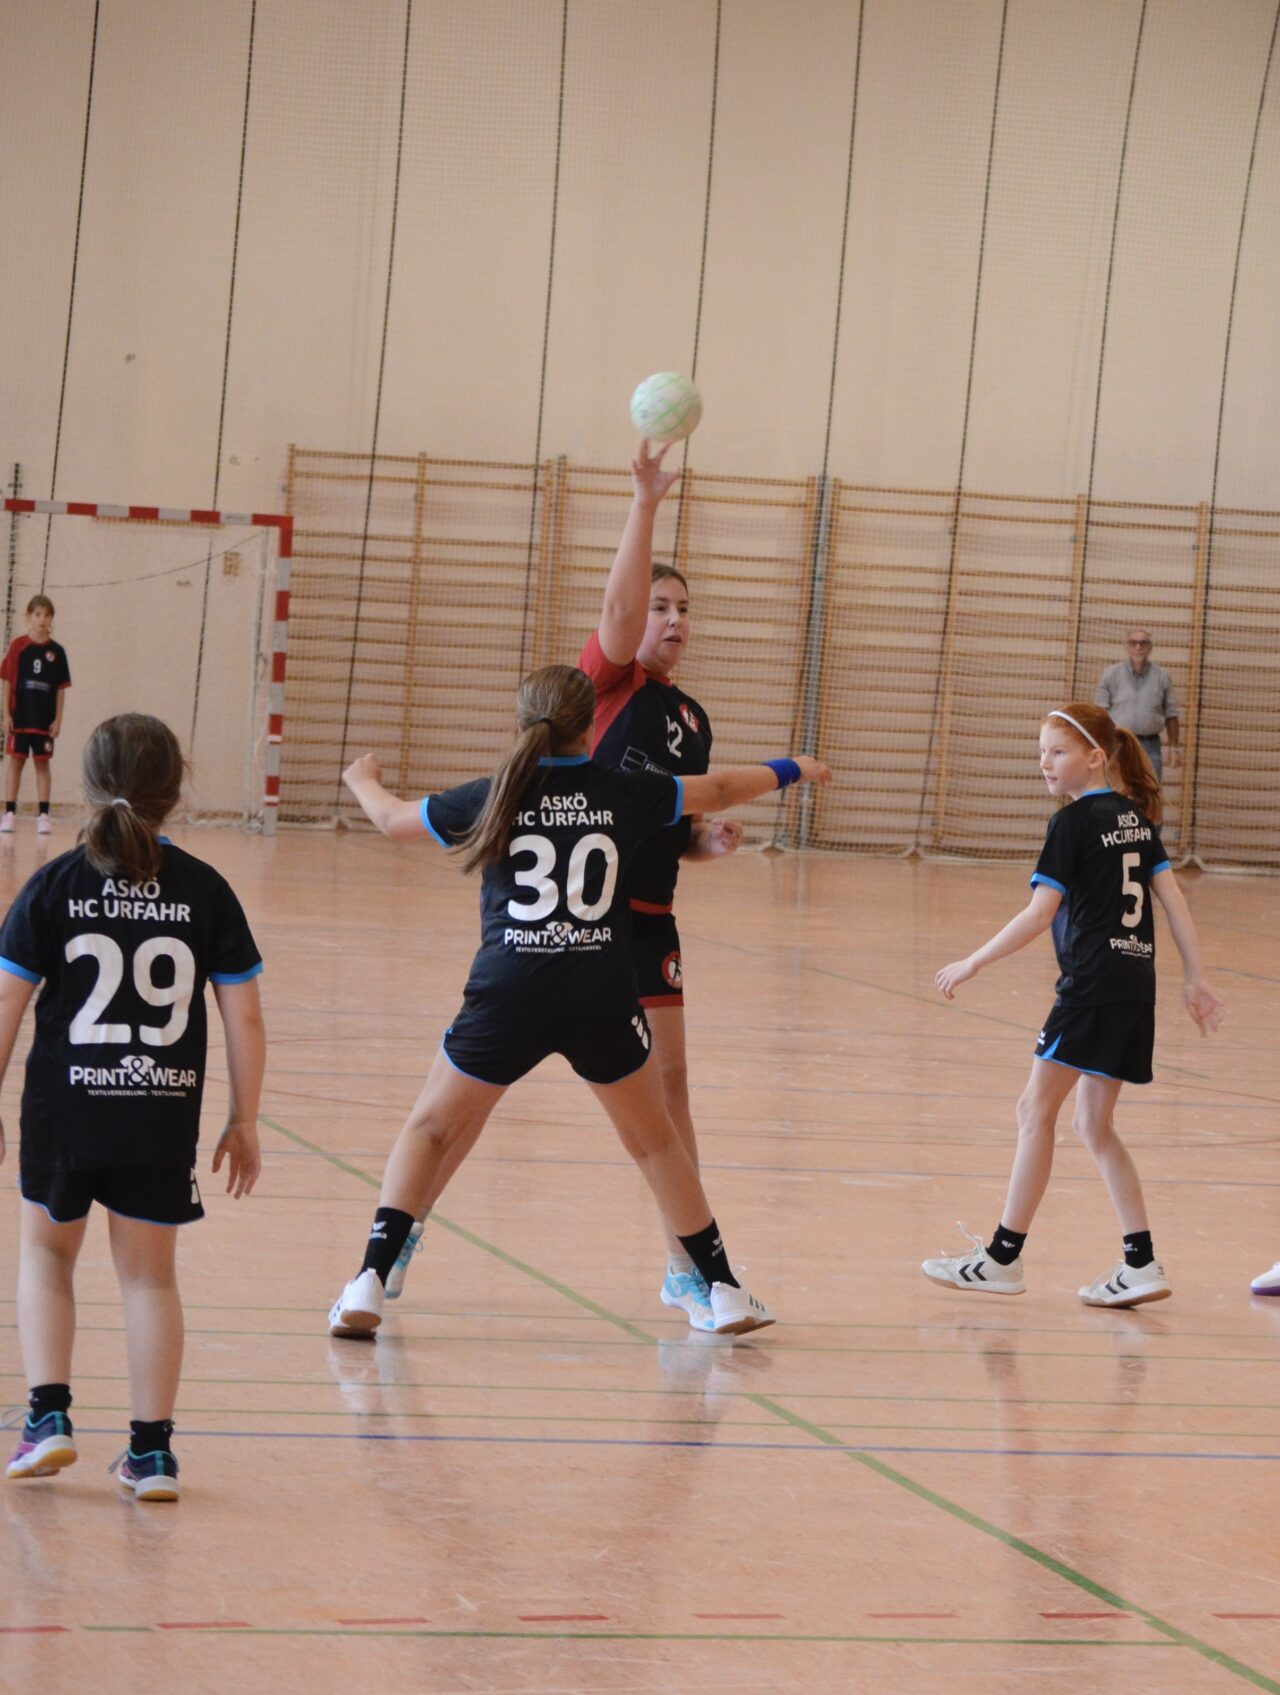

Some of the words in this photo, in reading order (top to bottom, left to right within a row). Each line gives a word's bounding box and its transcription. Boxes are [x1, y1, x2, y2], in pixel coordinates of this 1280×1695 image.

[33, 659, 41, 674] 9
[540, 792, 588, 810] ASKÖ
[540, 810, 614, 827] URFAHR
[1117, 811, 1139, 828] ASKÖ
[1101, 831, 1121, 848] HC
[102, 877, 161, 899] ASKÖ
[507, 833, 619, 922] 30
[1121, 852, 1144, 928] 5
[68, 899, 99, 918] HC
[103, 900, 191, 922] URFAHR
[65, 933, 196, 1047] 29
[69, 1056, 197, 1087] PRINT&WEAR
